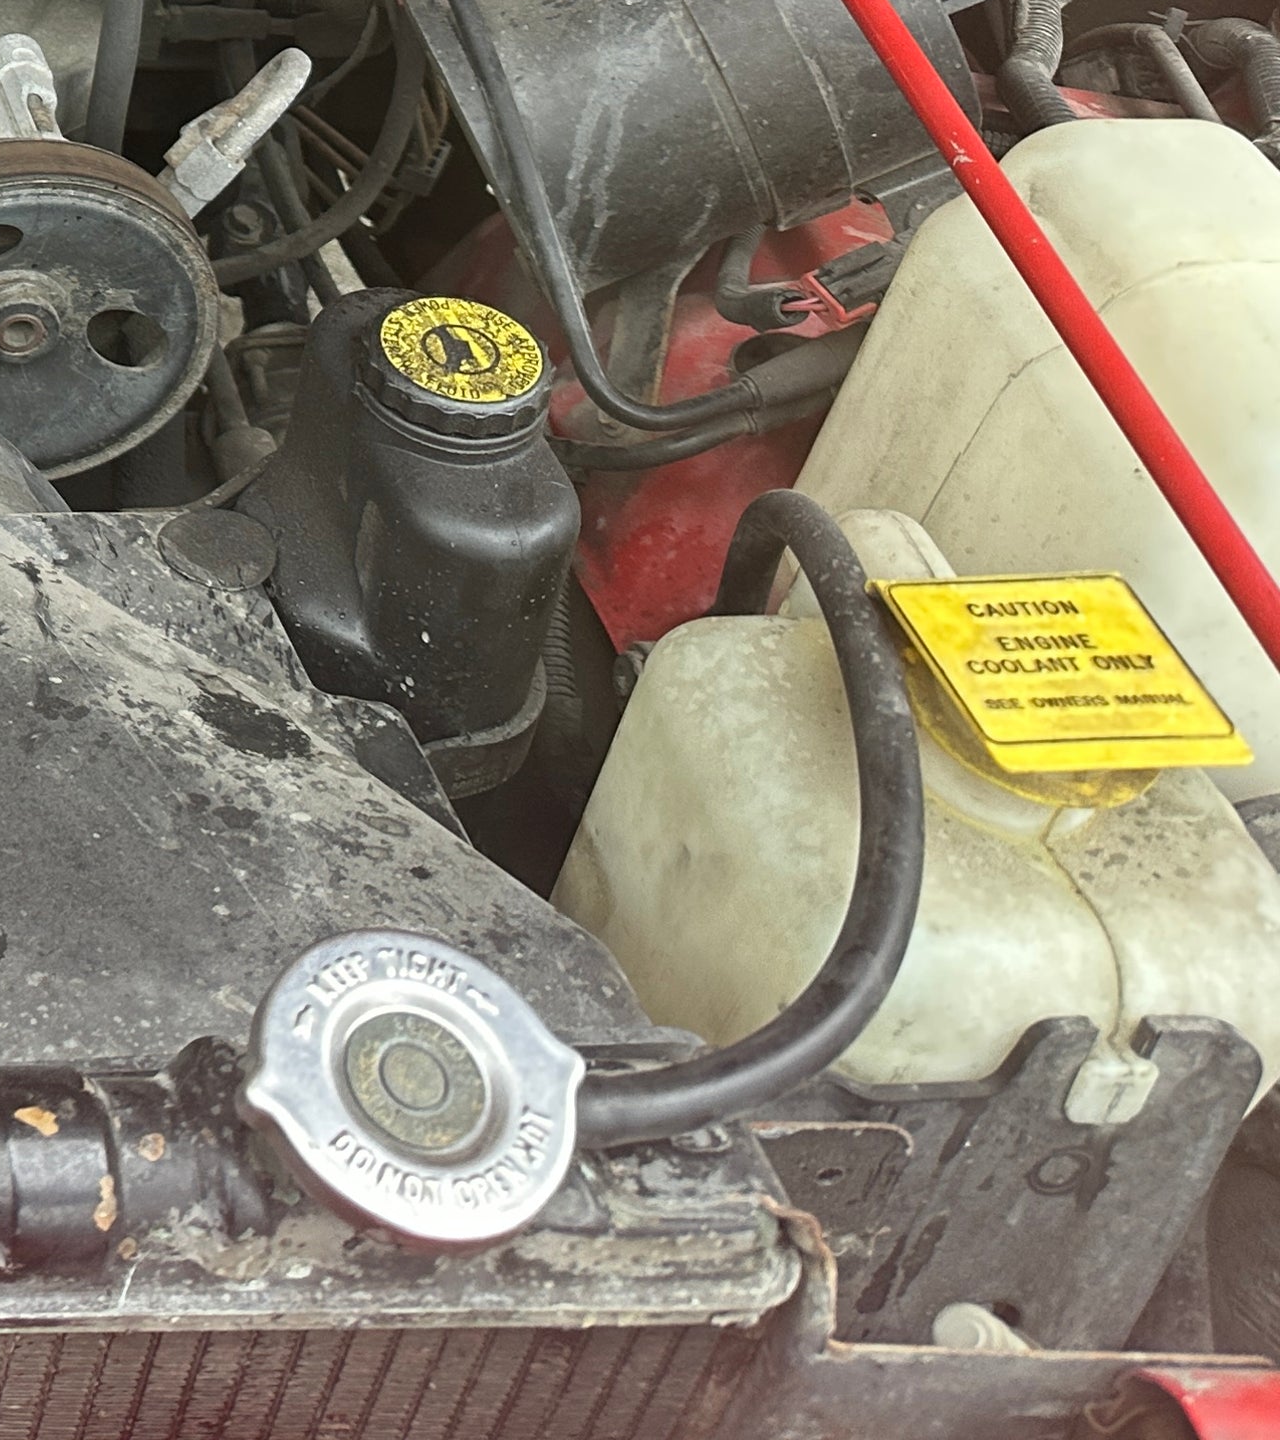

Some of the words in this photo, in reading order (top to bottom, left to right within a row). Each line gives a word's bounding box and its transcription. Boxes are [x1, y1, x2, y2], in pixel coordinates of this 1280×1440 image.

[966, 599, 1080, 620] CAUTION
[996, 633, 1098, 652] ENGINE
[966, 657, 1082, 676] COOLANT
[1090, 654, 1158, 672] ONLY
[983, 696, 1025, 711] SEE
[1031, 694, 1109, 710] OWNERS
[1118, 692, 1194, 707] MANUAL
[376, 945, 468, 996] TIGHT
[328, 1128, 376, 1175] DO
[376, 1162, 443, 1208] NOT
[451, 1154, 528, 1209] OPEN
